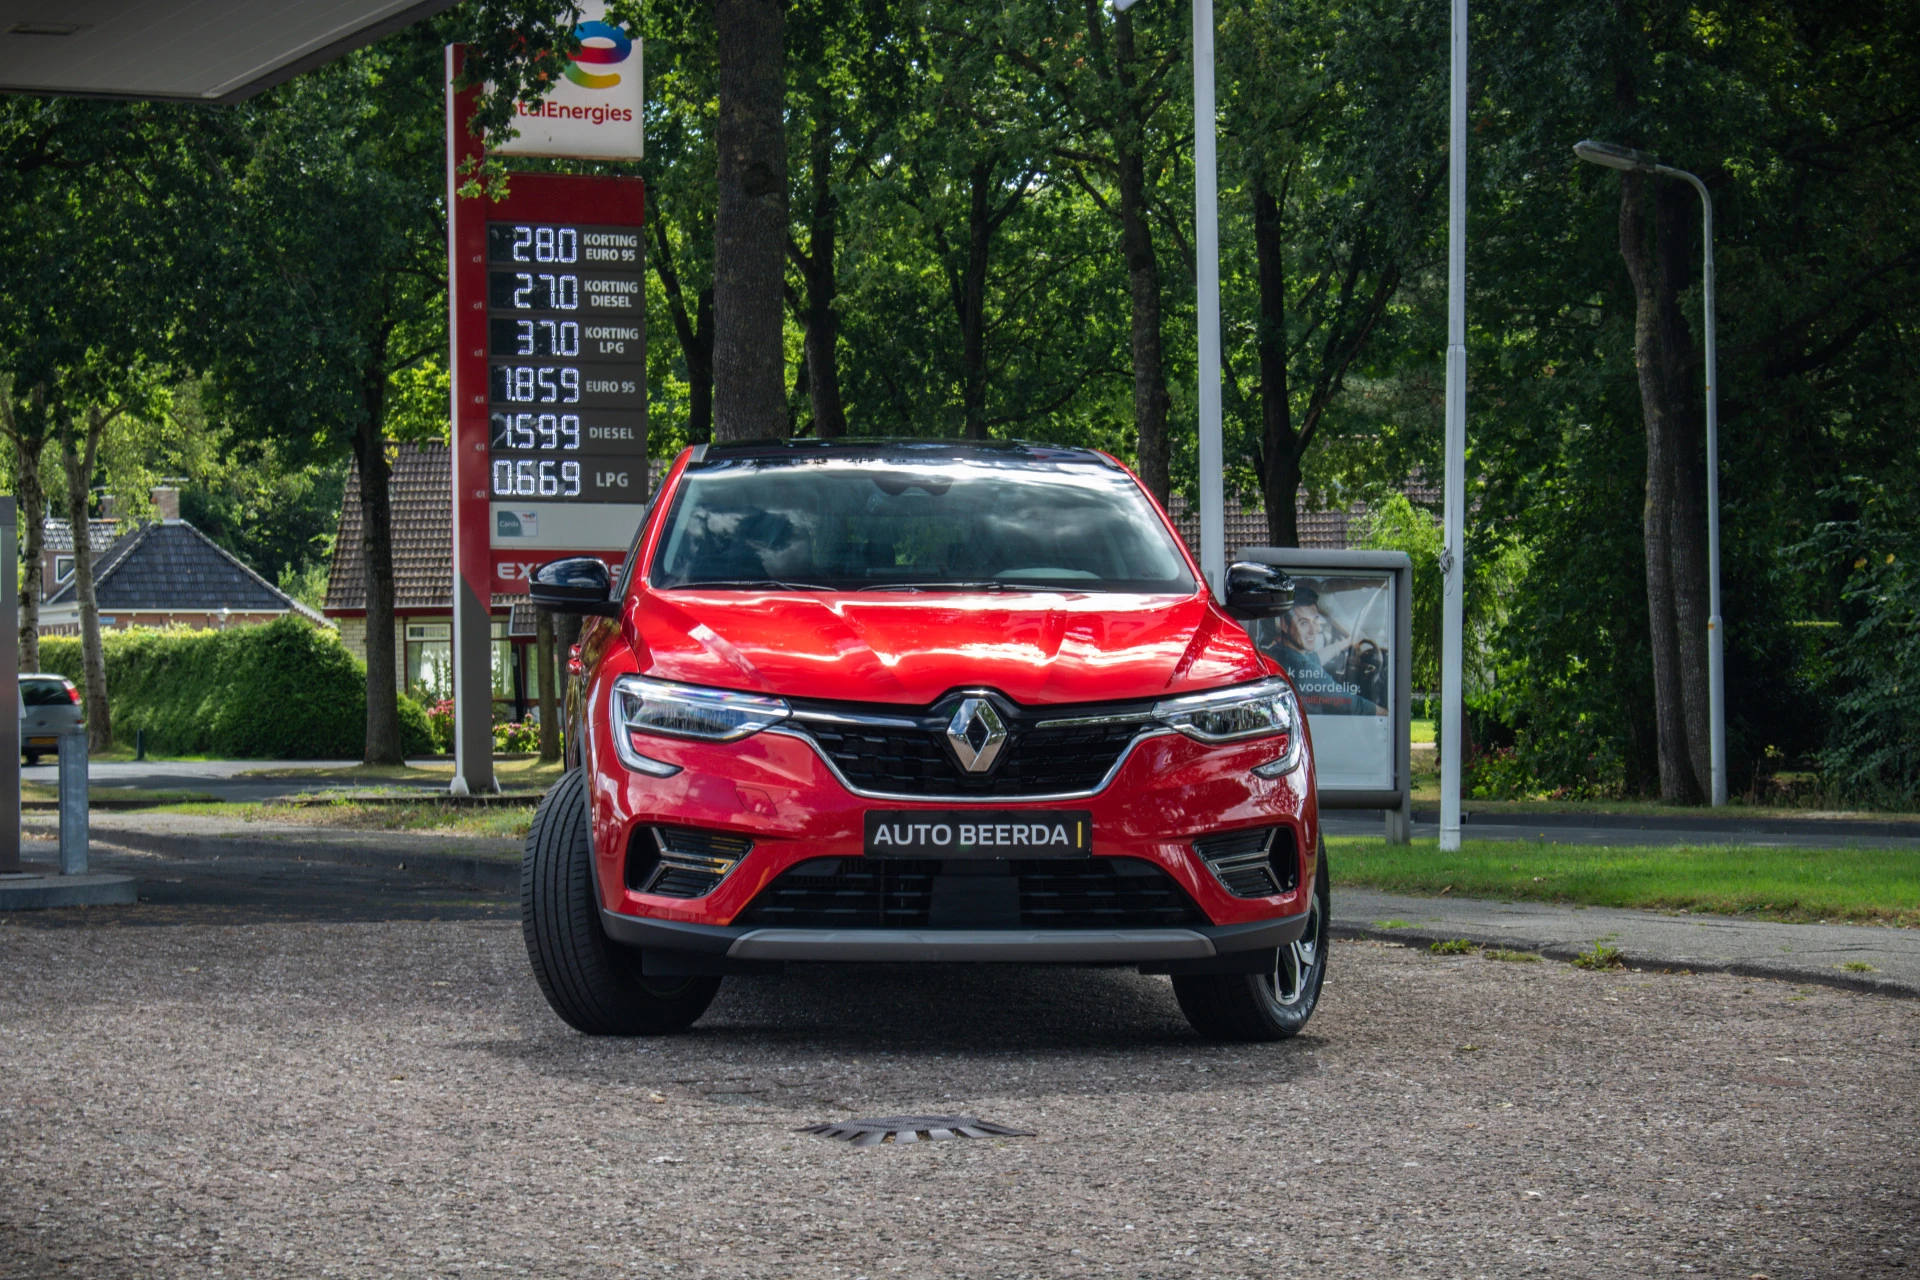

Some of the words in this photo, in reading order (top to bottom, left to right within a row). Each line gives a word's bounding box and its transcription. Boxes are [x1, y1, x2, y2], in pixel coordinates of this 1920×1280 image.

[513, 226, 578, 264] 28.0
[583, 233, 638, 247] KORTING
[585, 248, 618, 261] EURO
[621, 249, 636, 262] 95
[514, 273, 578, 310] 27.0
[584, 280, 639, 294] KORTING
[590, 295, 632, 308] DIESEL
[517, 320, 579, 357] 37.0
[585, 327, 639, 340] KORTING
[599, 341, 625, 354] LPG
[506, 366, 580, 403] 1.859
[586, 380, 618, 393] EURO
[621, 381, 636, 393] 95
[506, 413, 580, 450] 1.599
[589, 427, 635, 440] DIESEL
[493, 459, 580, 496] 0.669
[596, 471, 629, 488] LPG
[499, 520, 519, 528] Cards
[1299, 667, 1327, 679] snel.
[873, 823, 952, 846] AUTO
[959, 823, 1069, 846] BEERDA
